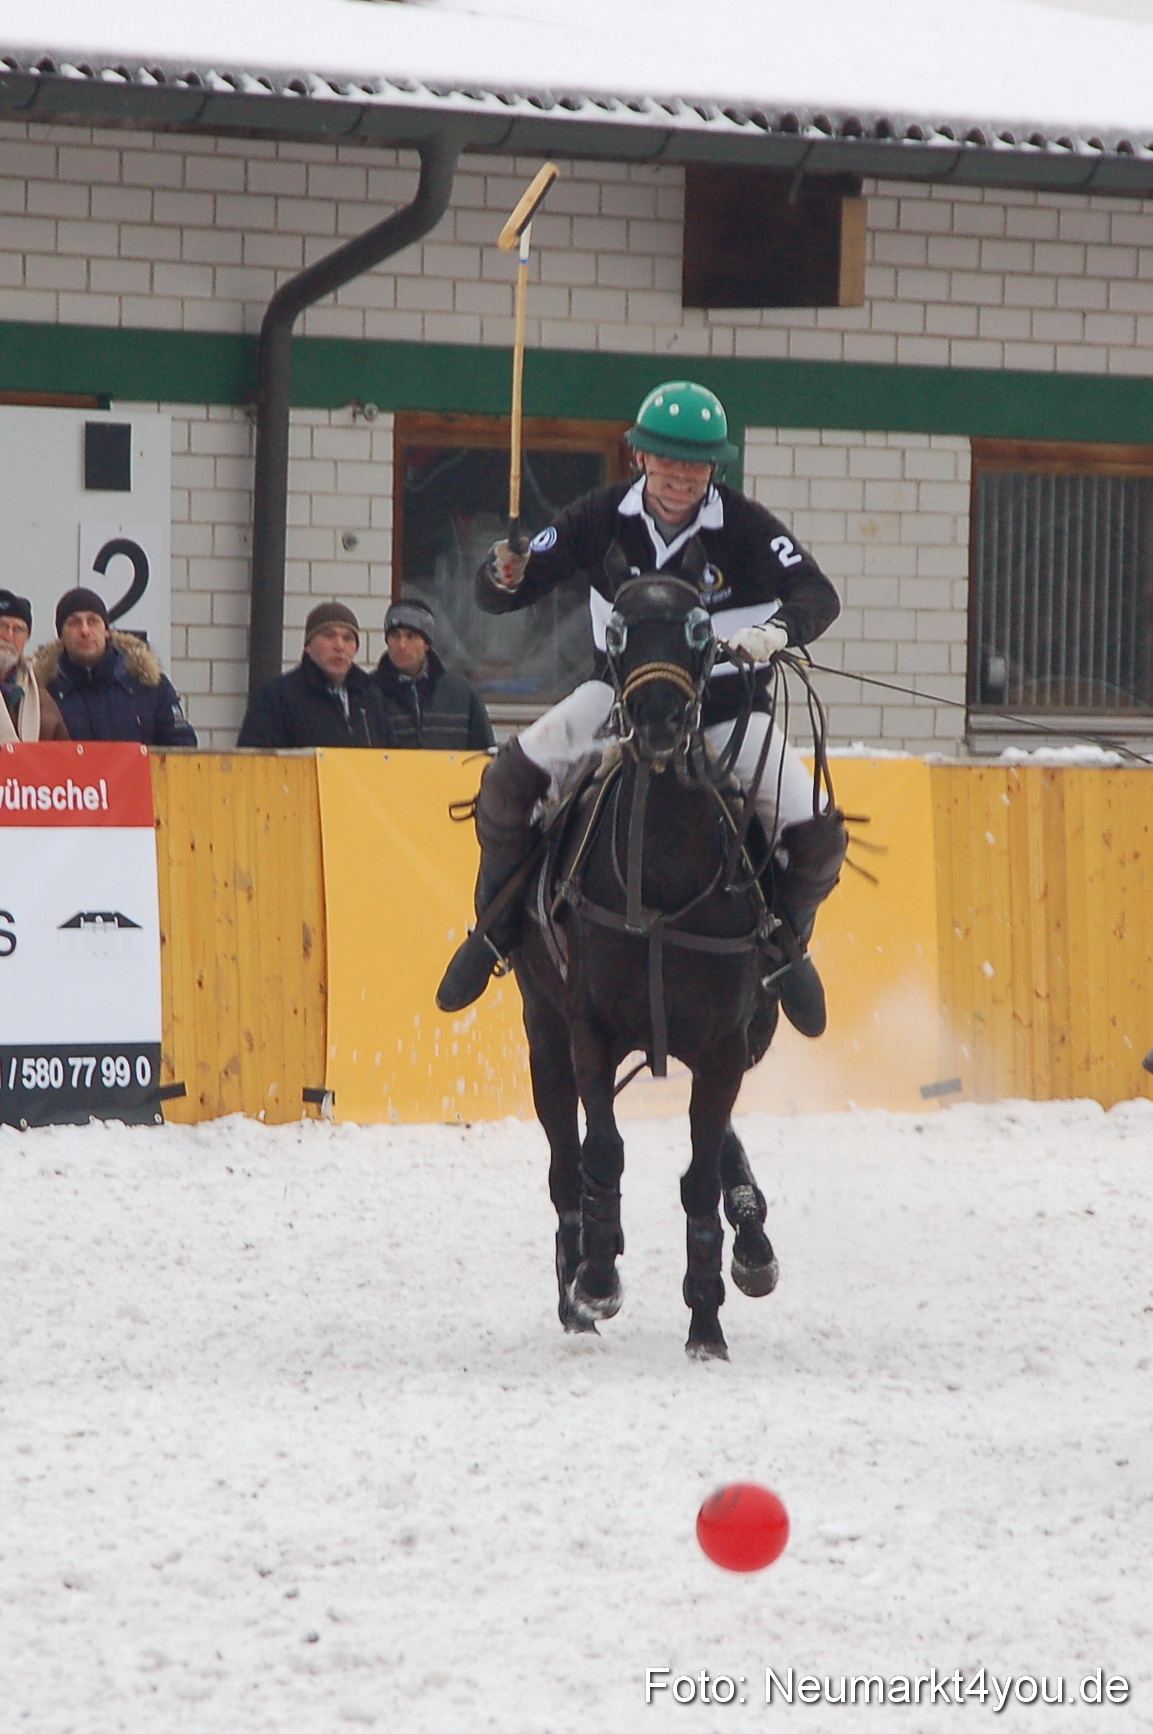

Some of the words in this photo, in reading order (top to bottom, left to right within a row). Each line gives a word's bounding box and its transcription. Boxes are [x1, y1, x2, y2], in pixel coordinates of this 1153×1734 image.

[770, 535, 802, 567] 2
[93, 538, 149, 641] 2
[0, 778, 108, 810] ünsche!
[22, 1057, 63, 1090] 580
[68, 1057, 97, 1088] 77
